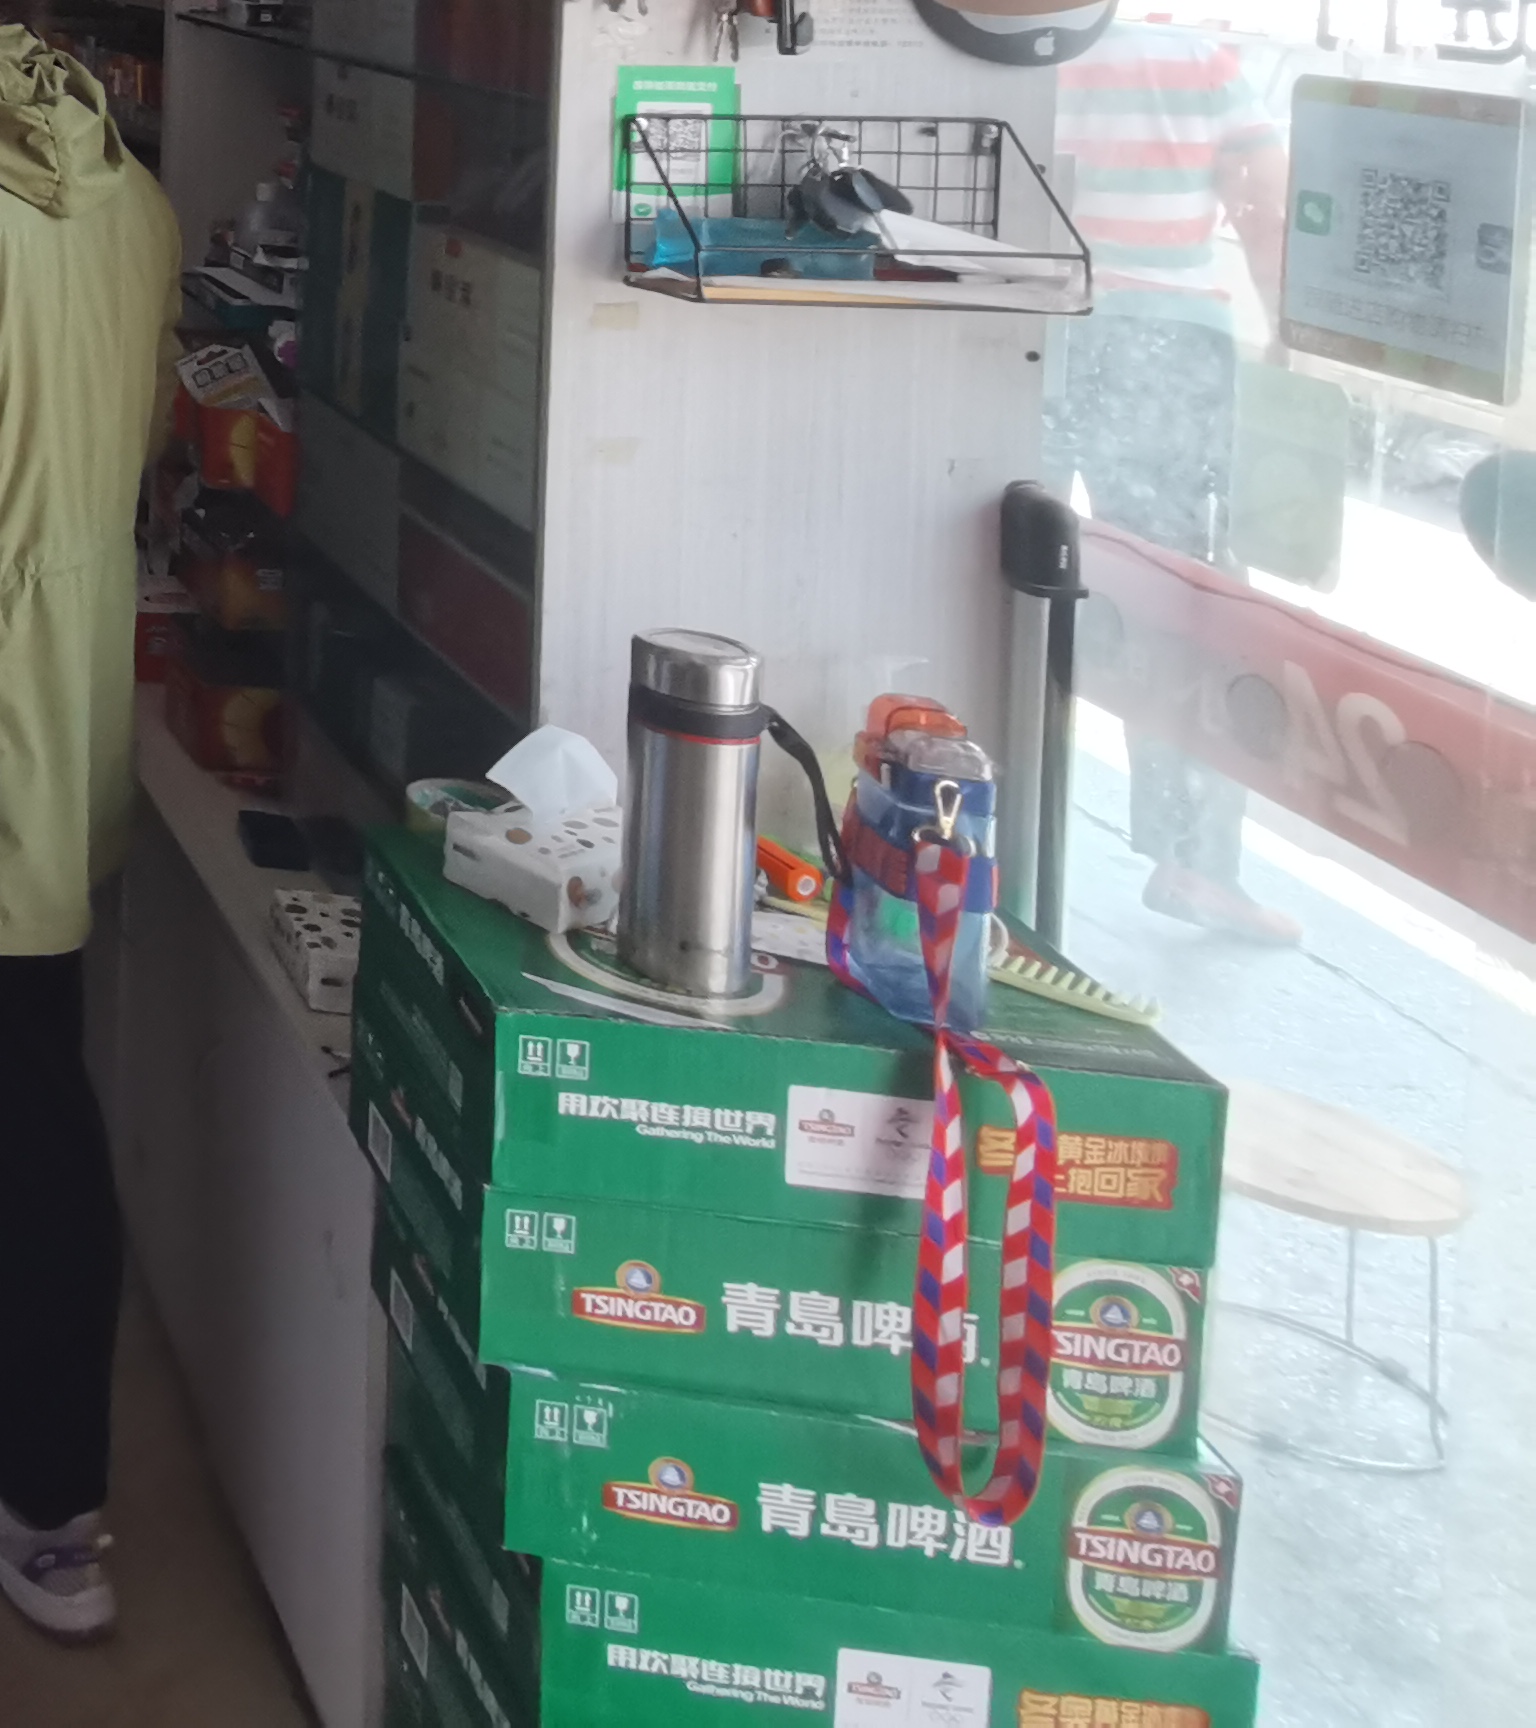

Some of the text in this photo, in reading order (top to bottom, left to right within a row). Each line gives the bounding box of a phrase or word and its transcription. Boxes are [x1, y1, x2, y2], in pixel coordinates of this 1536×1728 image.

[558, 1092, 776, 1136] 用欢聚连接世界
[635, 1124, 776, 1149] Gathering The World
[580, 1292, 697, 1327] TSINGTAO
[1062, 1368, 1157, 1399] 青岛啤酒
[611, 1485, 731, 1525] TSINGTAO
[757, 1481, 1013, 1567] 青岛啤酒
[1075, 1532, 1217, 1574] TSINGTAO
[1095, 1571, 1190, 1603] 青岛啤酒
[607, 1644, 826, 1698] 用欢聚连接世界
[685, 1679, 826, 1710] Gathering The World
